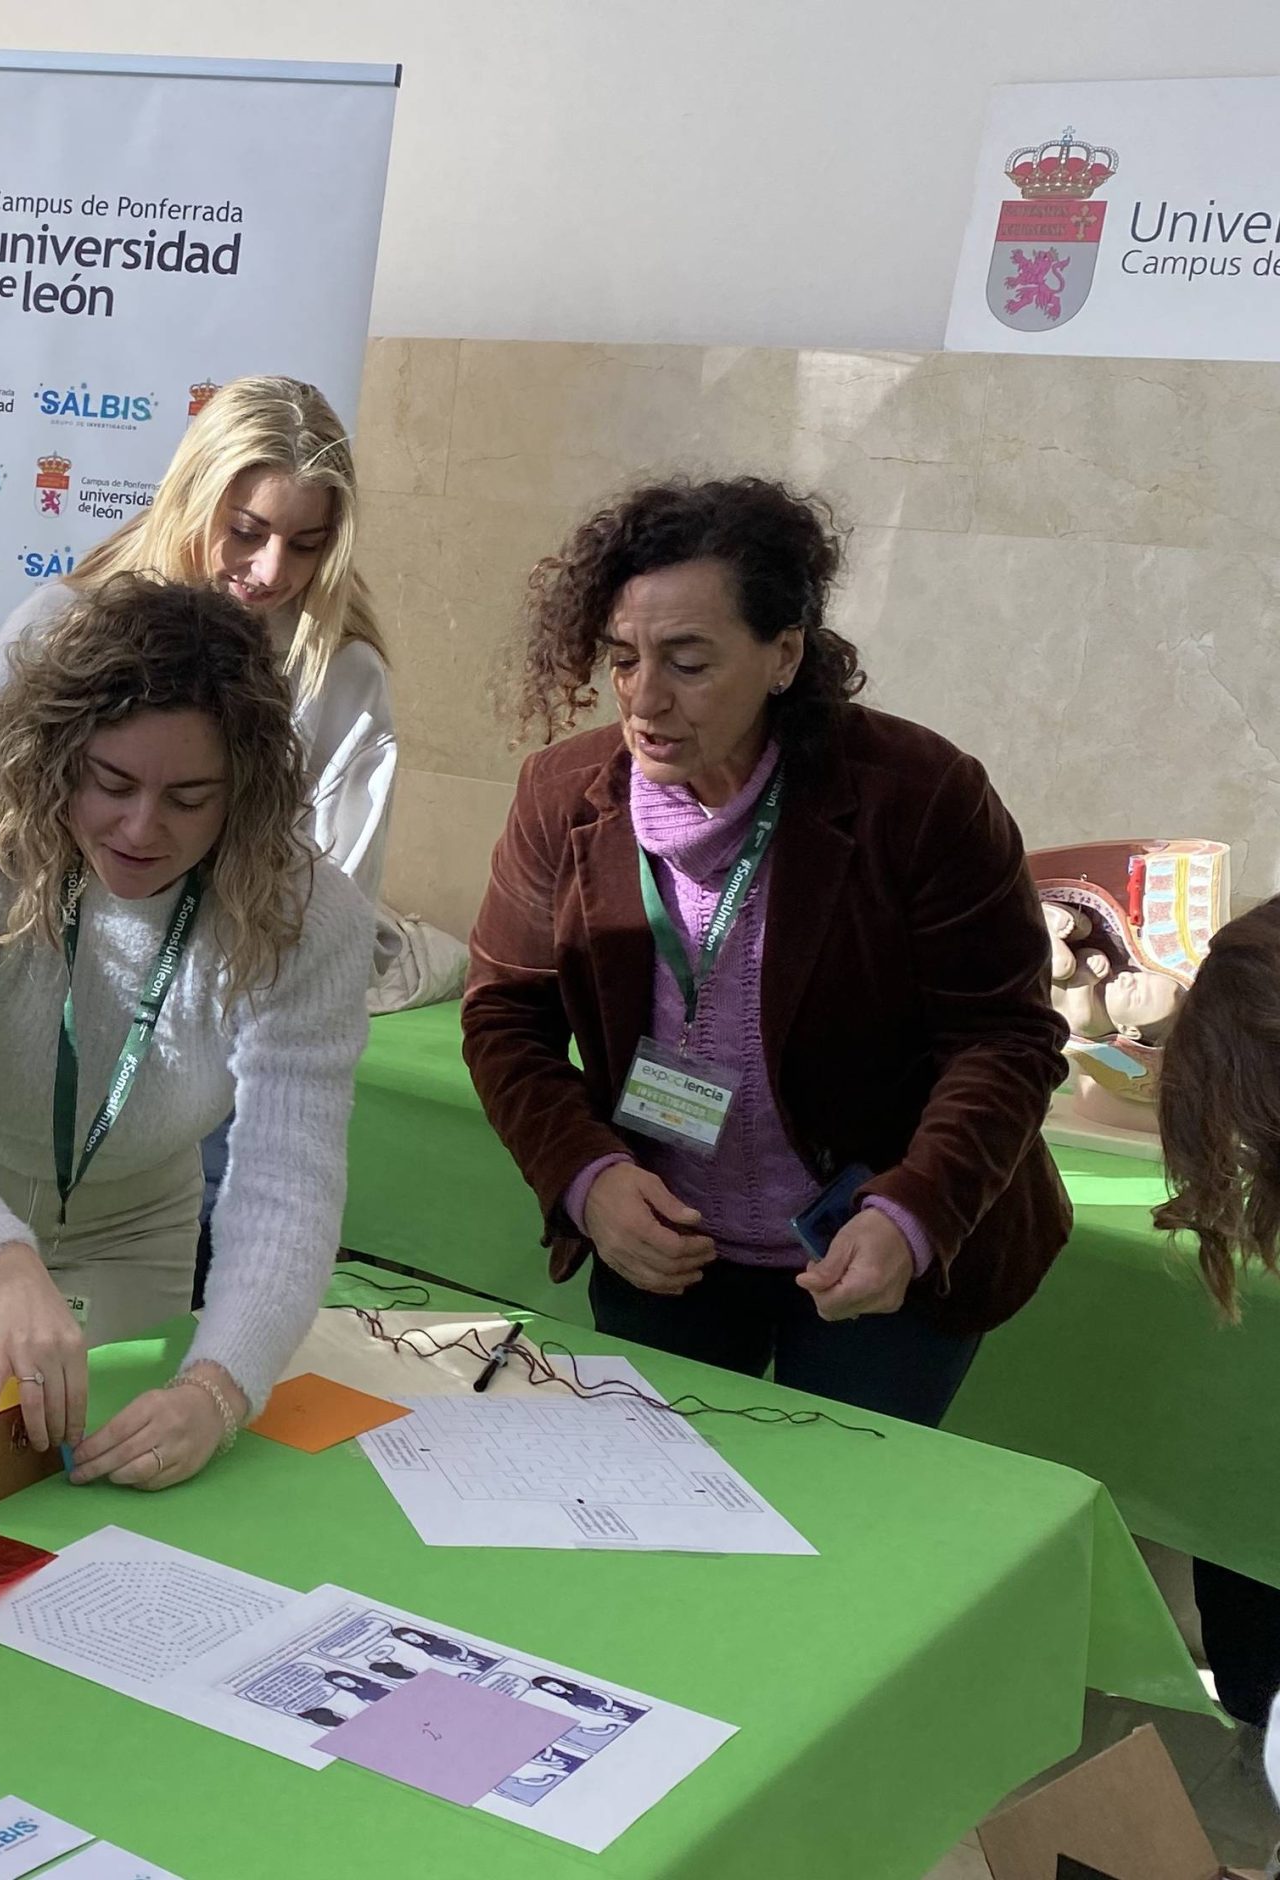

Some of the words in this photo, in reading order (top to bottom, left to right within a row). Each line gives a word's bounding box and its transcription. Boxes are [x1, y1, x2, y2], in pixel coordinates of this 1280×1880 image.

[81, 194, 109, 216] de
[118, 196, 244, 223] Ponferrada
[1130, 200, 1280, 244] Unive
[1121, 250, 1242, 281] Campus
[22, 271, 114, 317] león
[40, 389, 153, 422] SALBIS
[78, 502, 91, 513] de
[92, 504, 123, 519] león
[706, 858, 752, 951] #SomosUnileon
[150, 896, 196, 997] #SomosUnileon
[85, 1053, 138, 1153] #SomosUnileon
